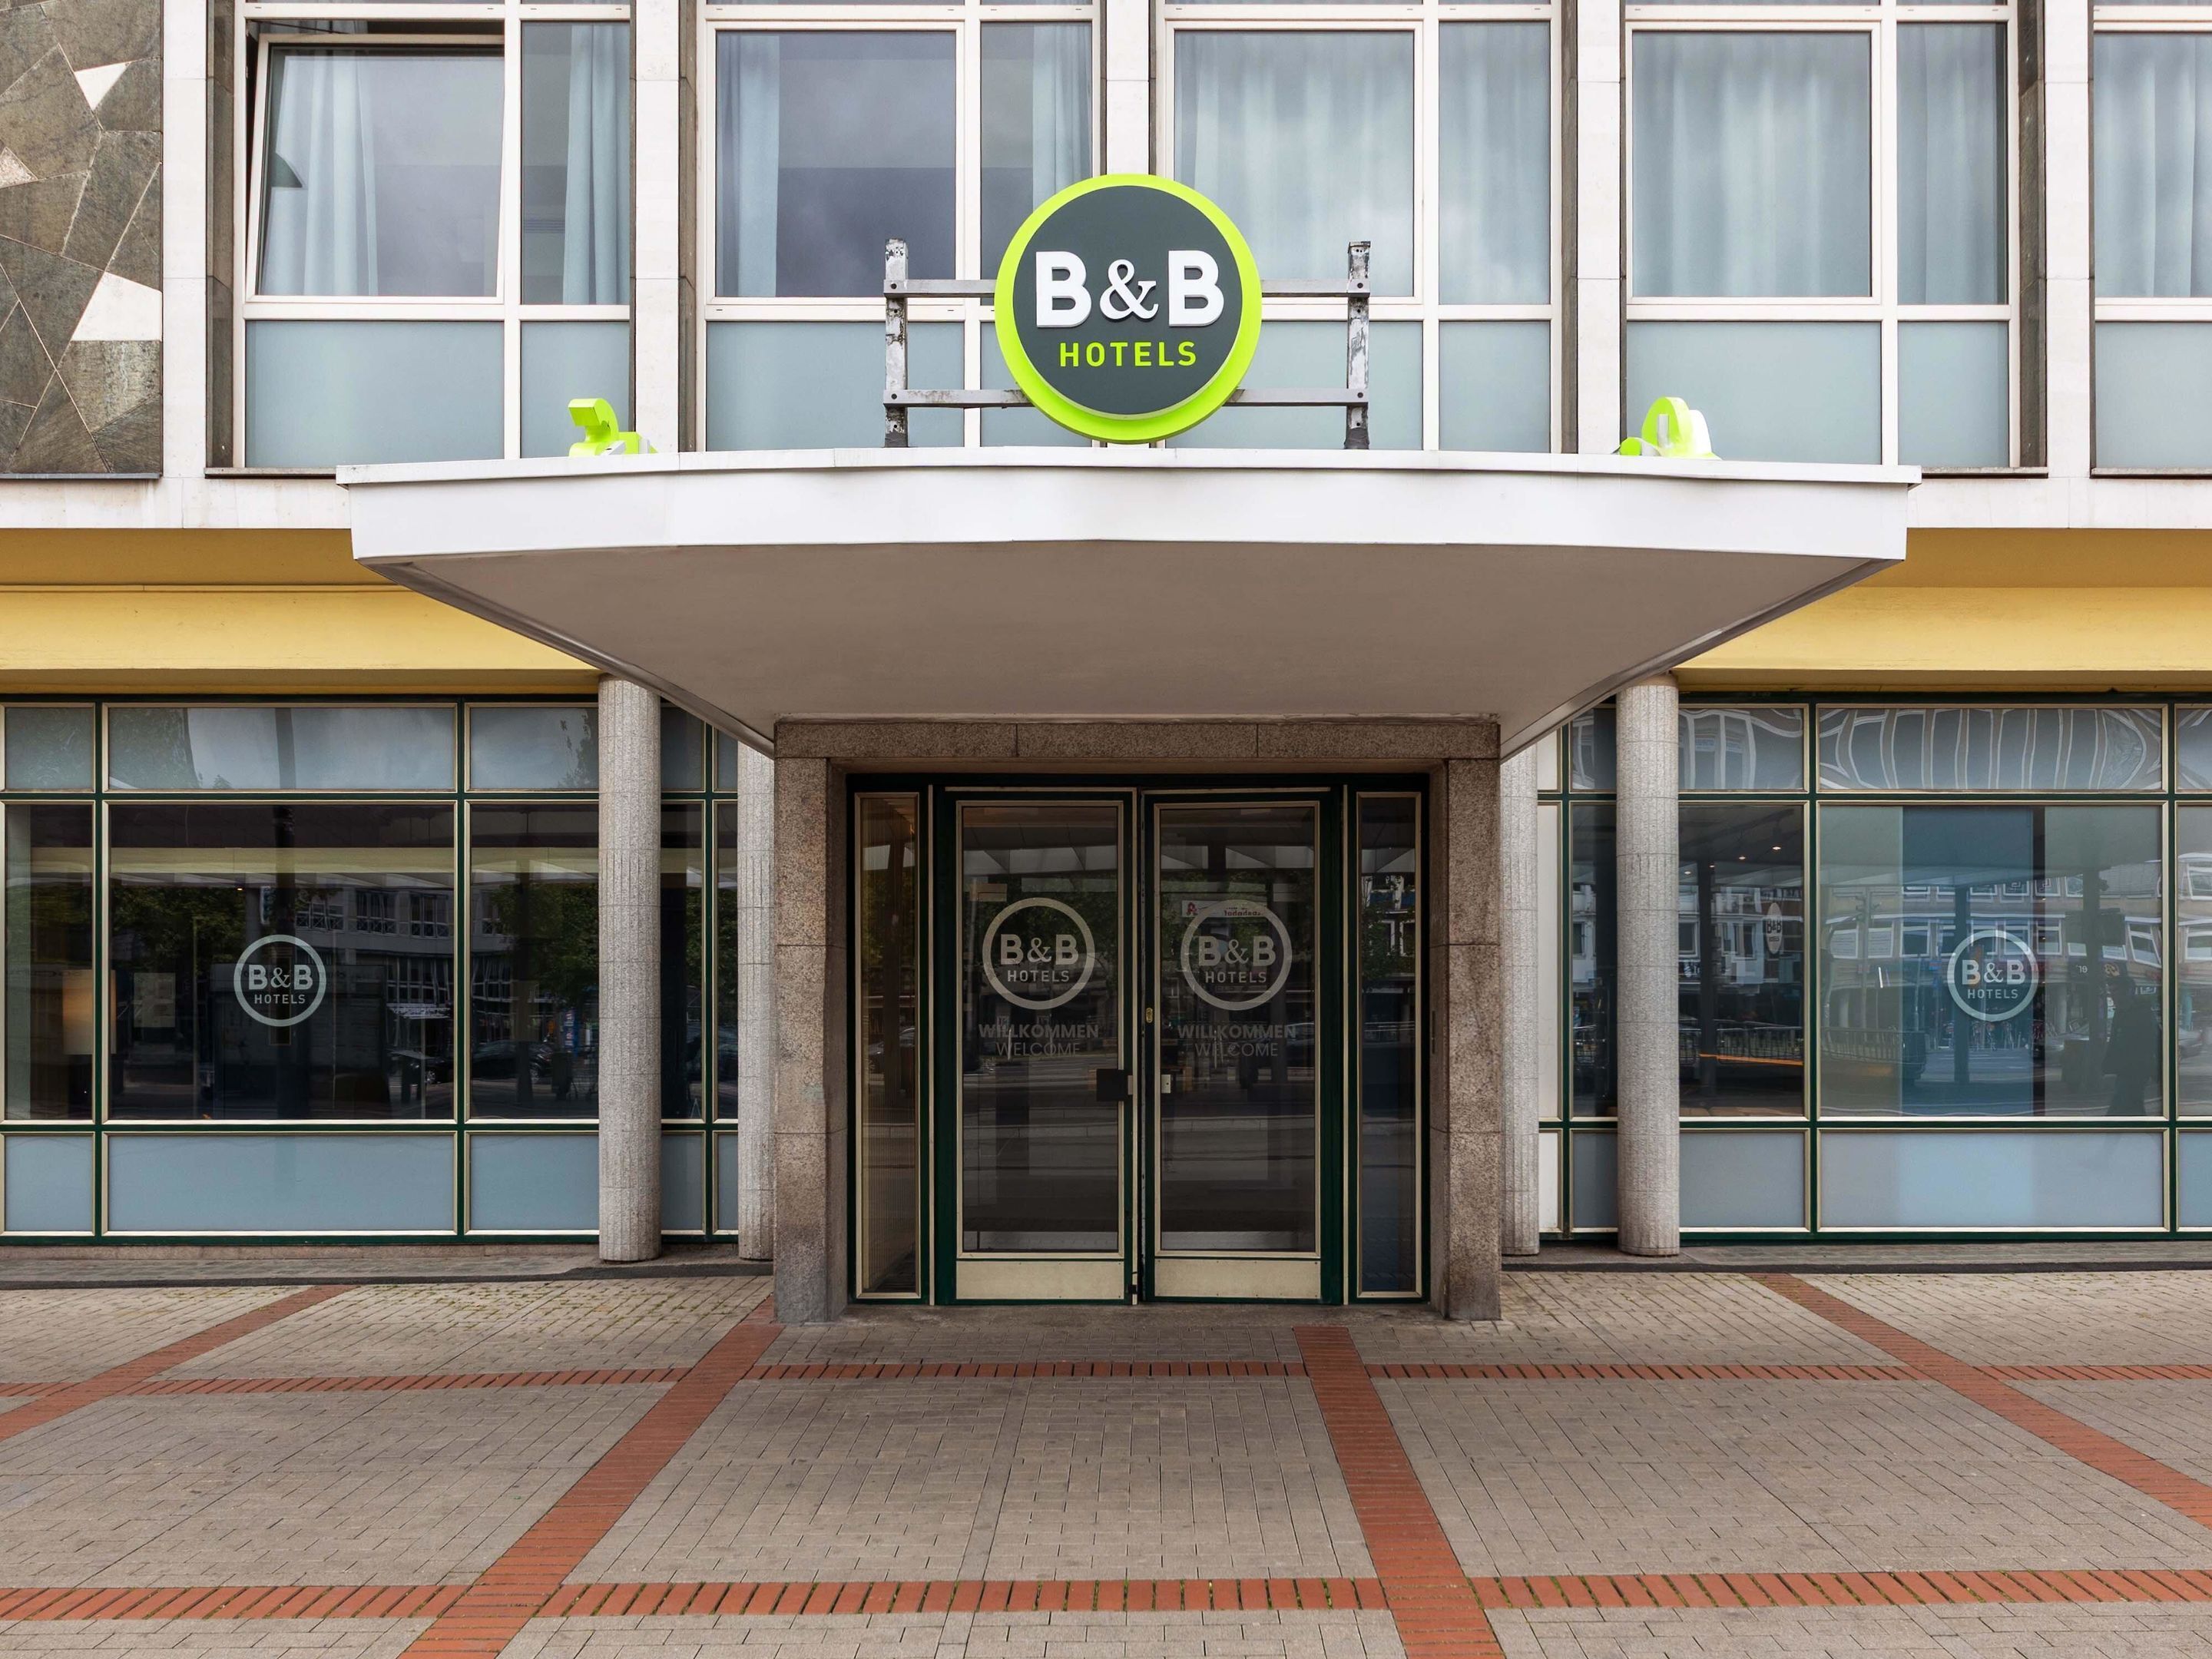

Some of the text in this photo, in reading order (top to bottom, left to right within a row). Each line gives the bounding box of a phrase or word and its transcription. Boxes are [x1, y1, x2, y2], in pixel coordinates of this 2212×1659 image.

[1035, 250, 1224, 328] B&B
[1060, 341, 1196, 367] HOTELS
[1000, 934, 1079, 965] B&B
[1198, 935, 1277, 967] B&B
[248, 964, 313, 990] B&B
[1007, 969, 1070, 982] HOTELS
[1205, 971, 1267, 983] HOTELS
[1962, 959, 2026, 985] B&B
[254, 994, 306, 1004] HOTELS
[1967, 988, 2018, 999] HOTELS
[979, 1024, 1099, 1038] WILLKOMMEN
[1177, 1025, 1296, 1038] WILLKOMMEN
[995, 1041, 1080, 1056] WELCOME
[1194, 1042, 1279, 1057] WELCOME
